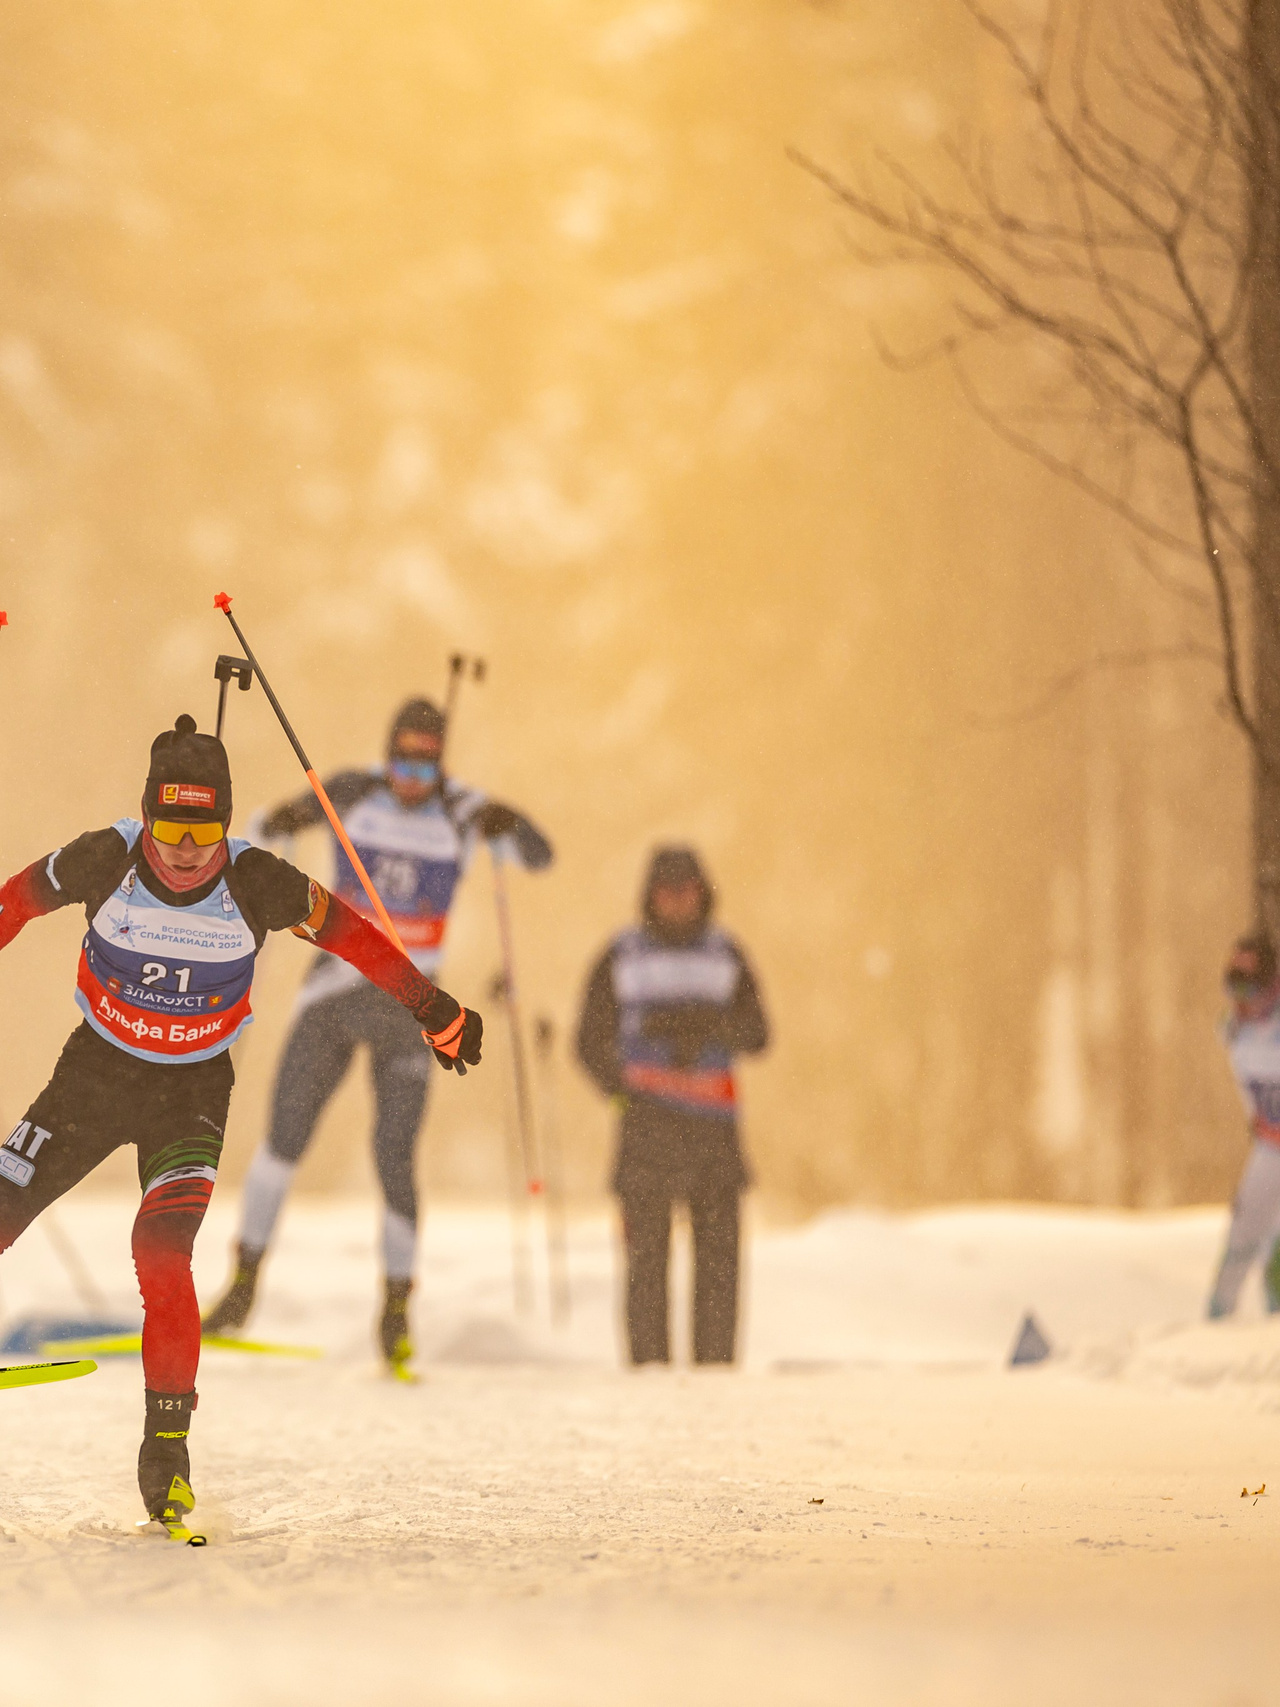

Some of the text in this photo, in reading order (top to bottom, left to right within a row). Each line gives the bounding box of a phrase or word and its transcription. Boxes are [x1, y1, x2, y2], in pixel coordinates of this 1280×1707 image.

[140, 932, 243, 949] СПАРТАКИАДА 2024
[162, 925, 243, 940] ВСЕРОССИЙСКАЯ
[141, 962, 191, 993] 21
[124, 984, 205, 1007] ЗЛАТОУСТ
[97, 996, 223, 1043] Альфа Банк
[157, 1399, 182, 1410] 121
